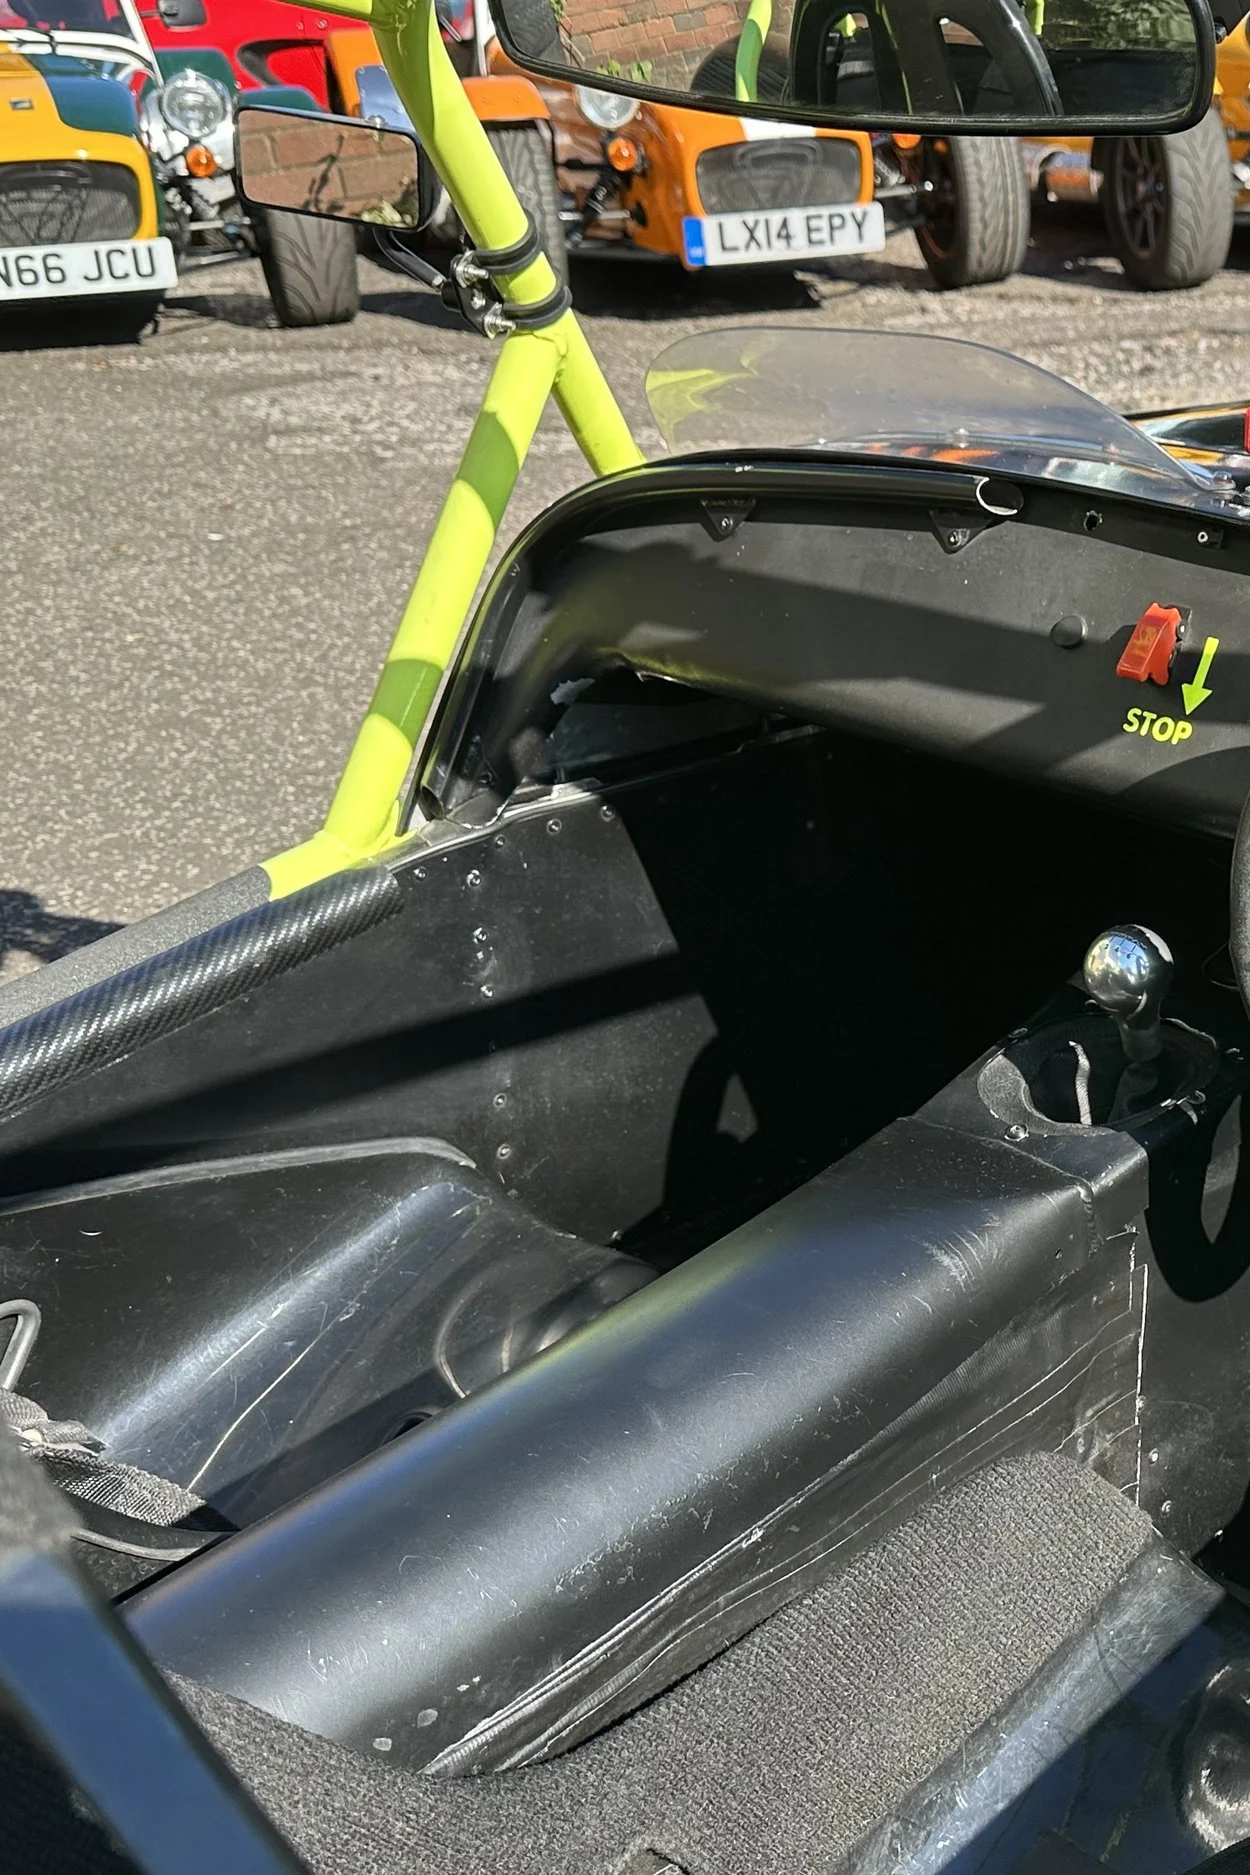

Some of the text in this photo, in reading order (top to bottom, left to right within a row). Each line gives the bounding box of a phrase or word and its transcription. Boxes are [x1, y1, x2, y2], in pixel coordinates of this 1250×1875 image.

[718, 208, 869, 253] LX14 EPY
[83, 247, 156, 281] JCU
[1122, 707, 1193, 745] STOP
